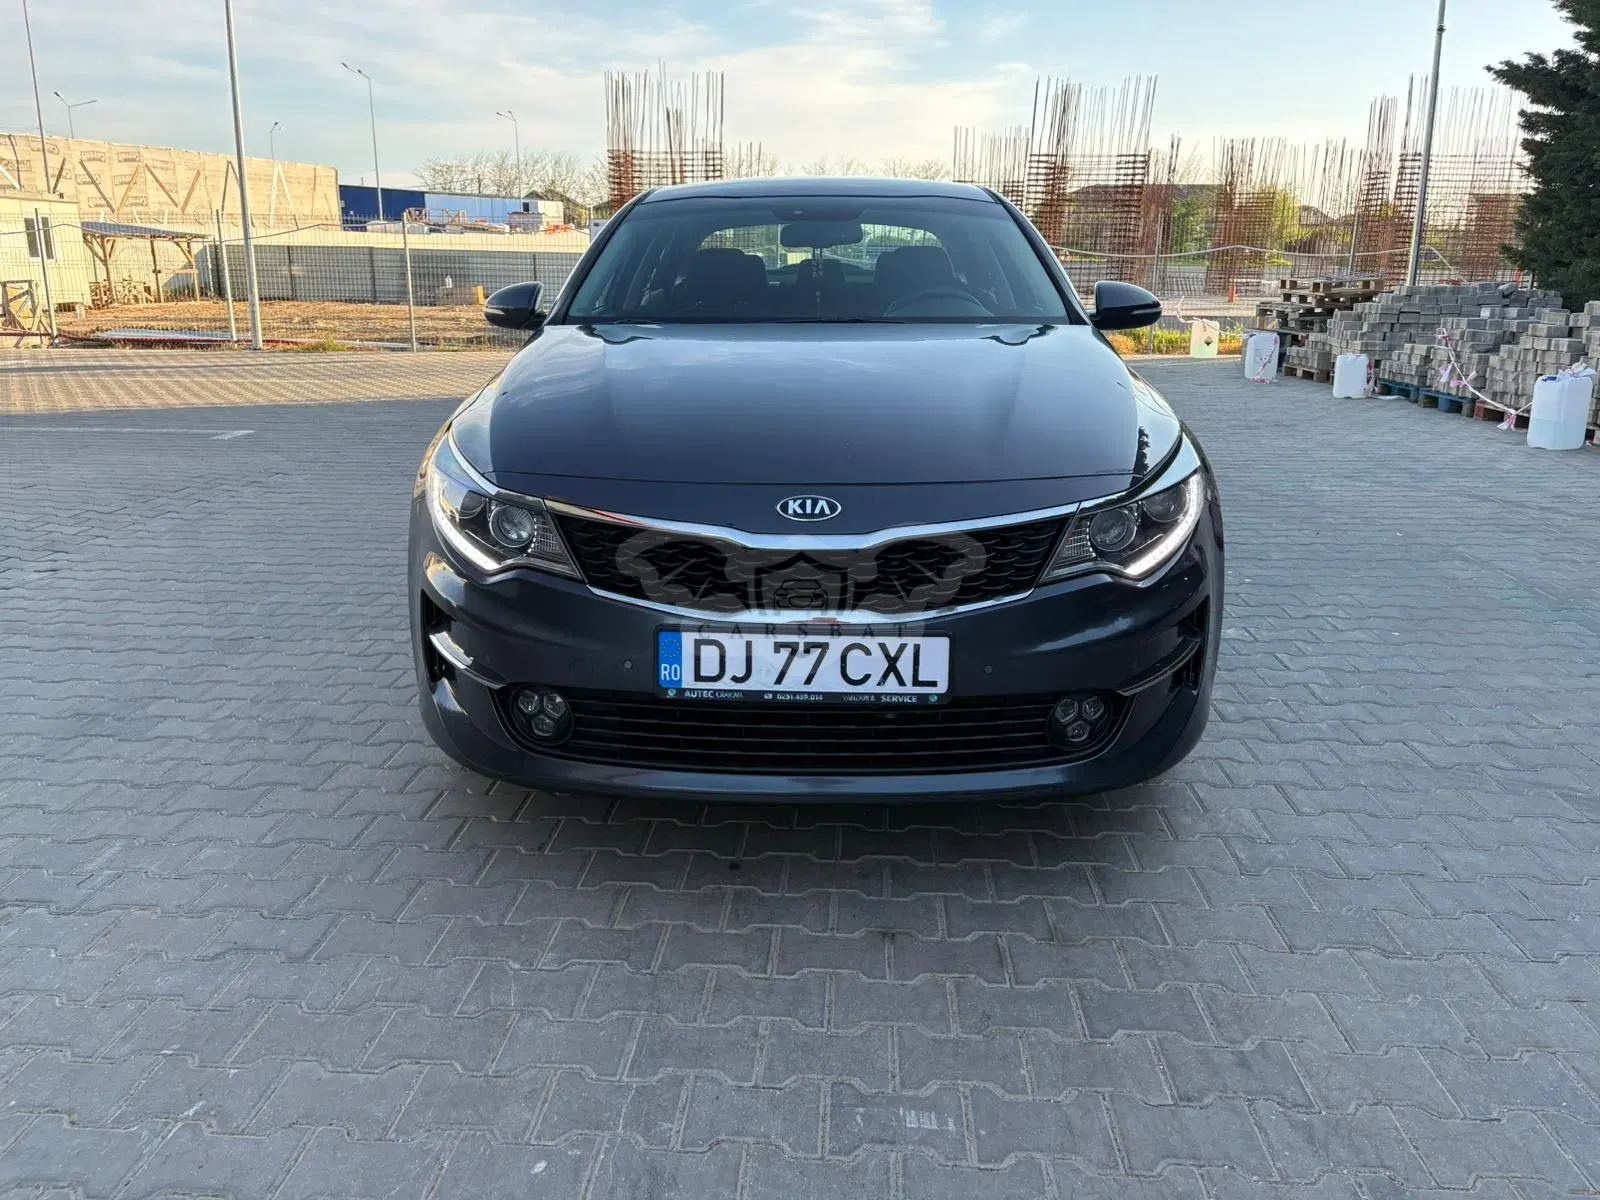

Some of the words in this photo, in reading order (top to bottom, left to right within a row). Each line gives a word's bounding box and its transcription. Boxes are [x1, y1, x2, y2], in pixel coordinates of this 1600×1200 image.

[788, 499, 831, 515] KIA
[693, 638, 753, 684] DJ
[773, 641, 830, 686] 77
[840, 642, 939, 688] CXL
[661, 663, 681, 682] RO
[684, 690, 714, 699] AUTEC
[880, 695, 918, 704] SERVICE
